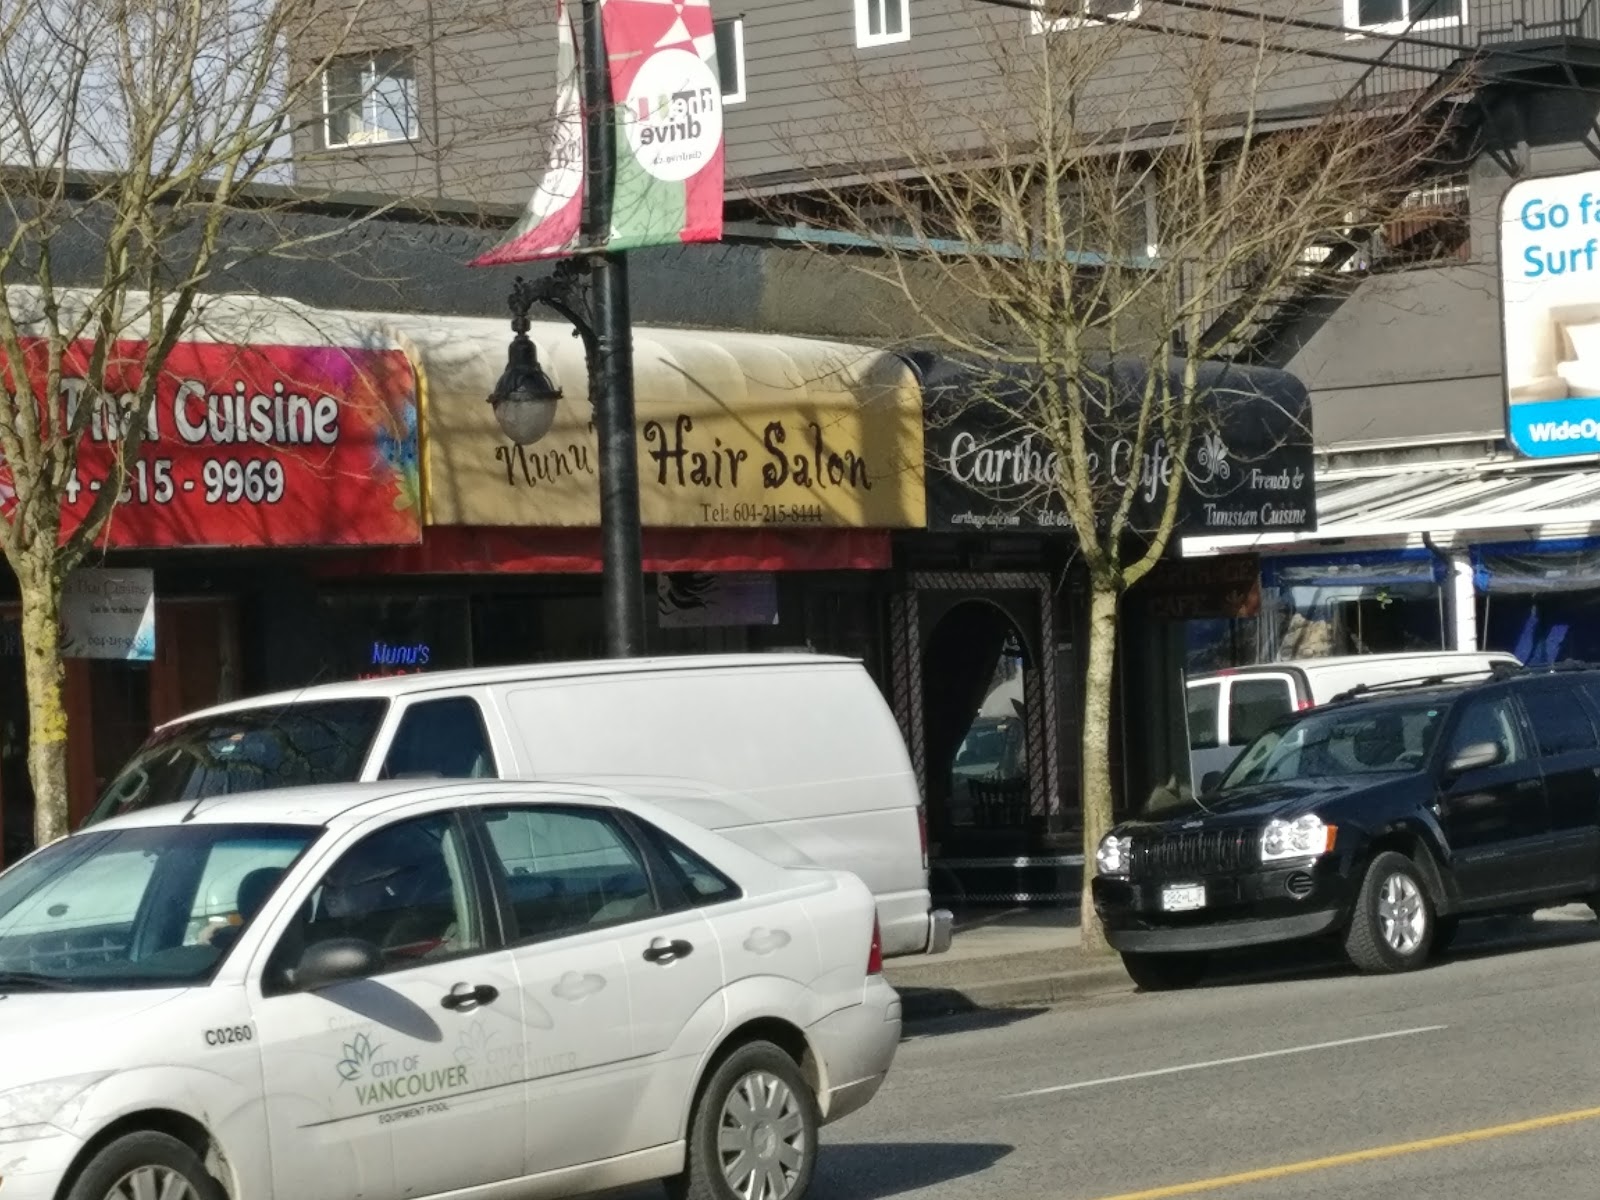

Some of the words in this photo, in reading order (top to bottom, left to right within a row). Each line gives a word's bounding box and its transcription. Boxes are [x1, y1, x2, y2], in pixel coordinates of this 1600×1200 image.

[1521, 198, 1569, 232] Go
[1523, 238, 1598, 278] Surf
[174, 380, 339, 444] Cuisine
[643, 414, 748, 487] Hair
[762, 420, 872, 490] Salon
[949, 431, 1100, 486] Carthae
[202, 459, 285, 503] 9969
[1250, 467, 1290, 490] French
[699, 502, 729, 522] Tel:
[732, 502, 823, 523] 604-215-8444
[1203, 502, 1258, 526] Tunisian
[1261, 502, 1306, 525] Cuisine
[205, 1025, 252, 1046] C0260
[371, 1059, 400, 1078] CITY
[403, 1055, 420, 1072] OF
[355, 1065, 469, 1106] VANCOUVER
[379, 1107, 425, 1125] EQUIPMENT
[426, 1102, 450, 1116] POOL
